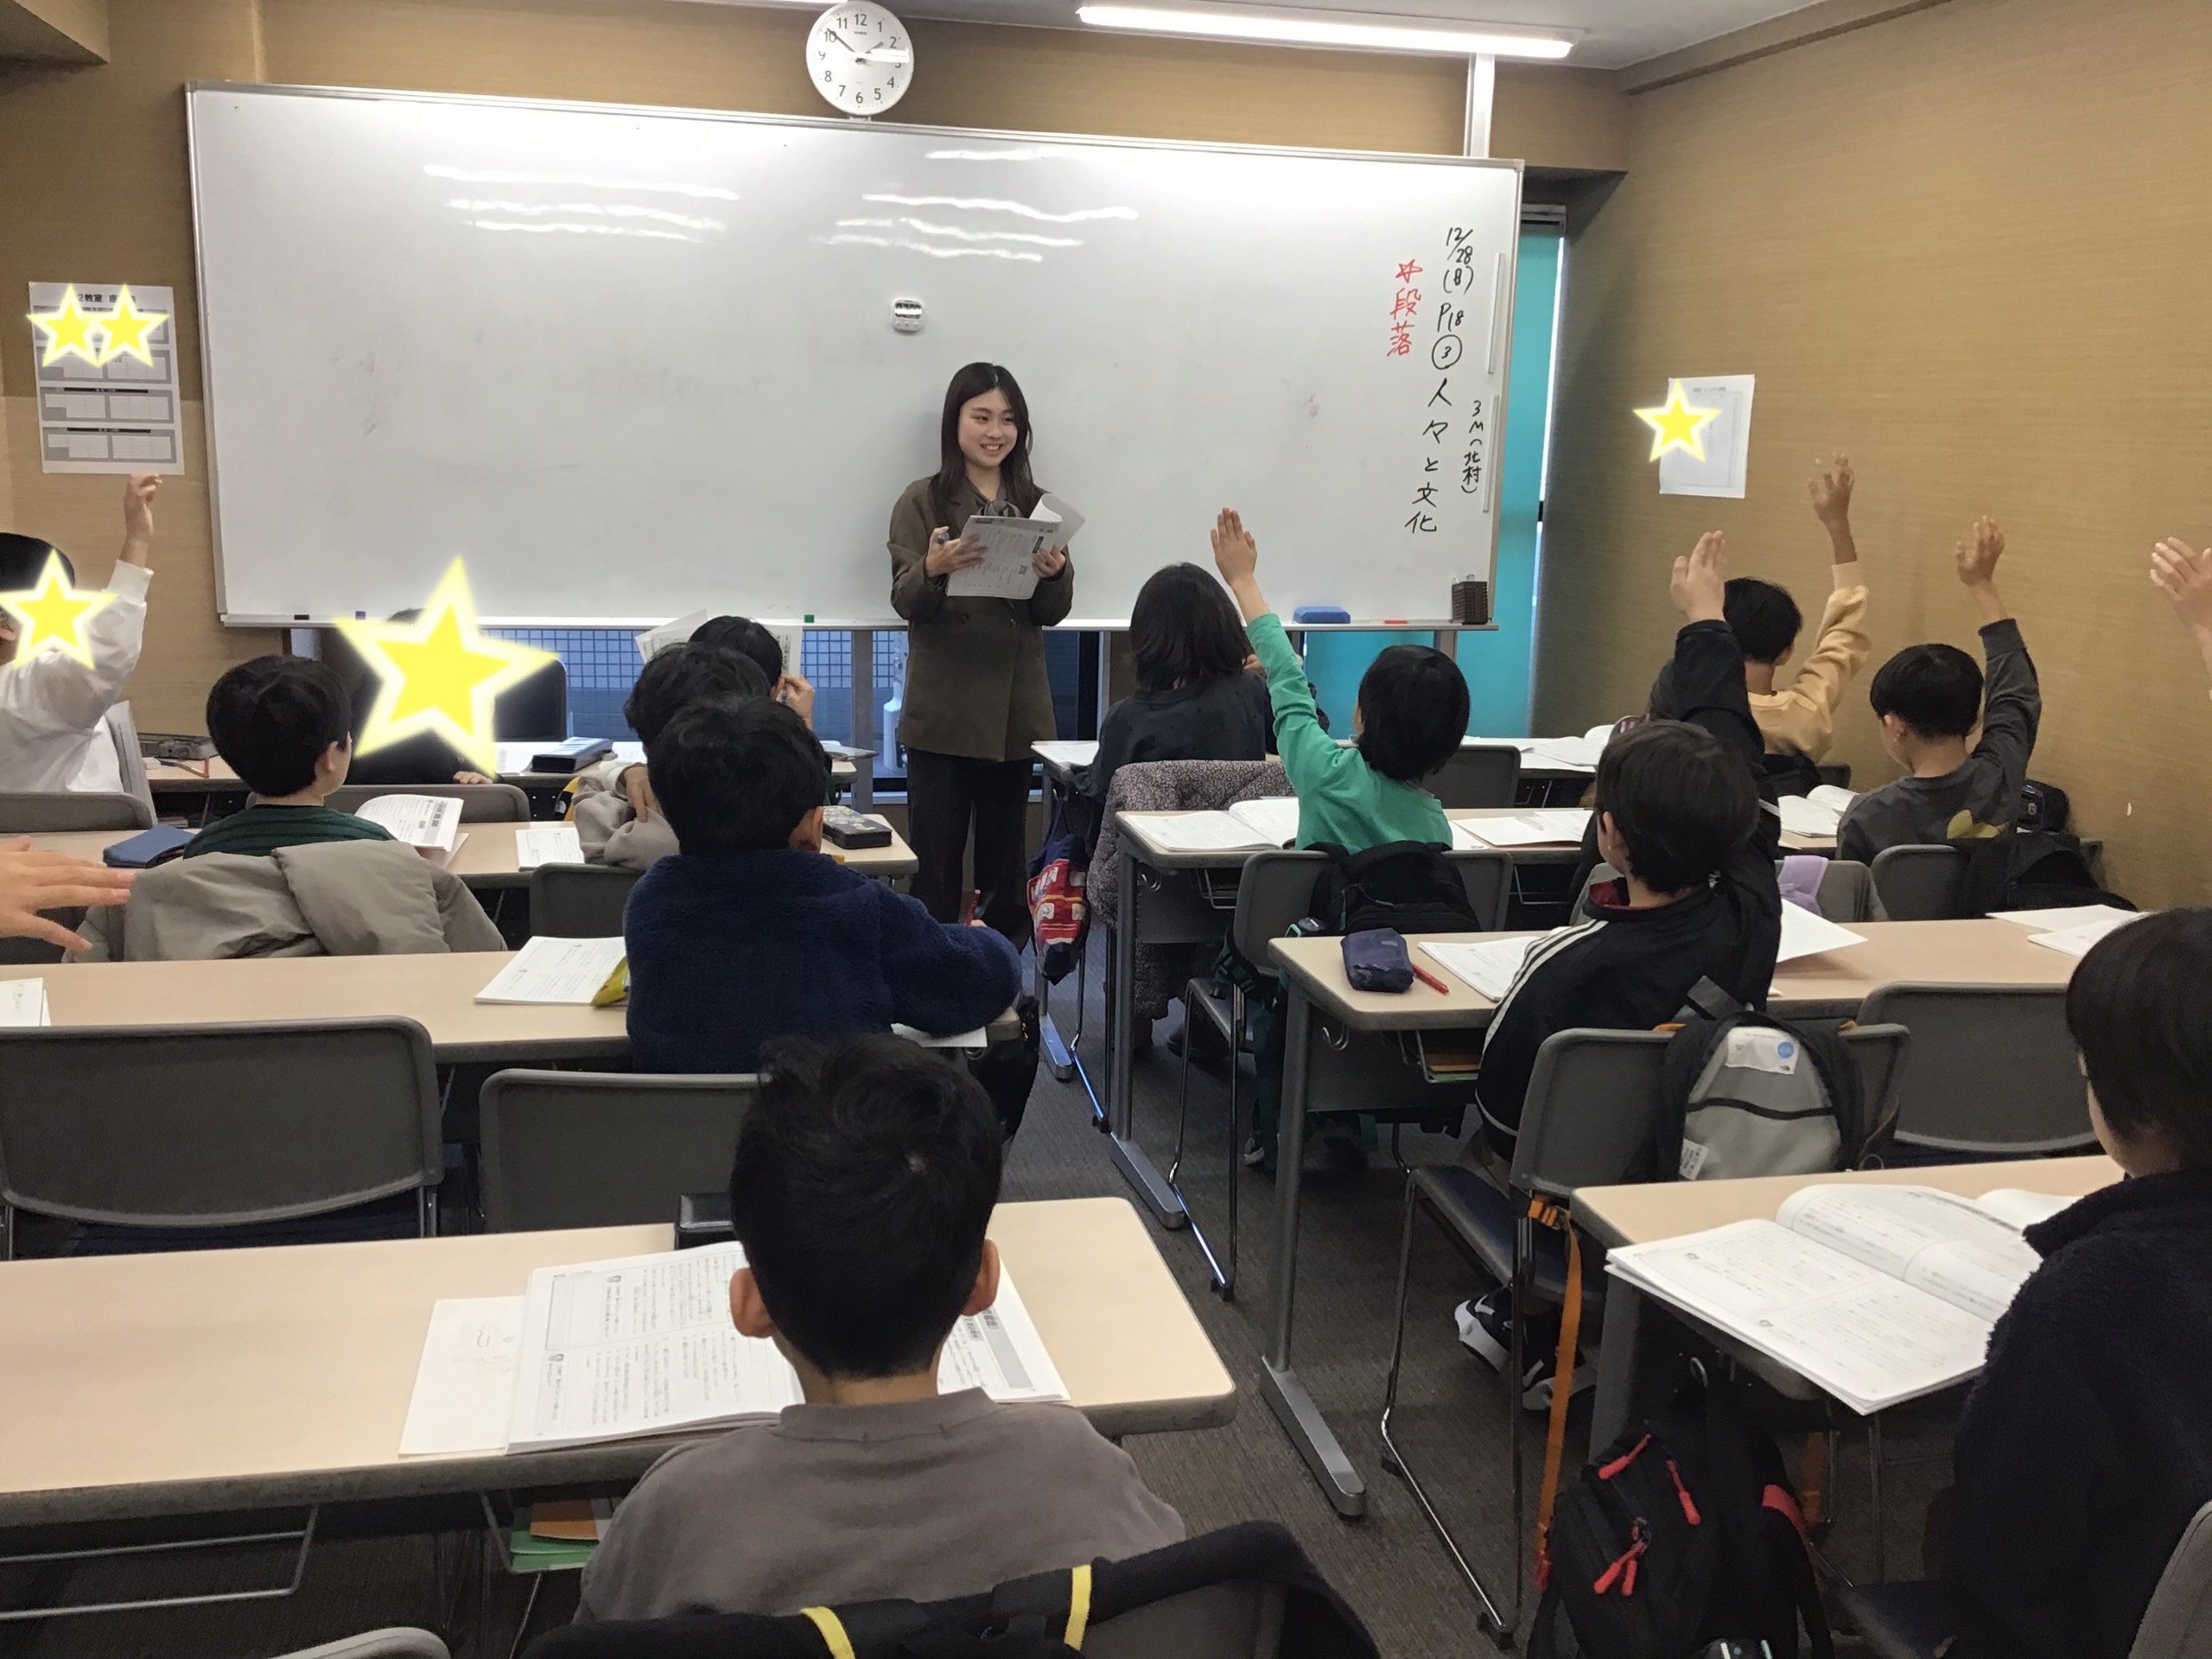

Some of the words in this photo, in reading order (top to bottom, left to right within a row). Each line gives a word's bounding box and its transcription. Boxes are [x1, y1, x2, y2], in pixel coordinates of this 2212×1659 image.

[836, 17, 848, 29] 11
[854, 14, 868, 26] 12
[877, 22, 882, 33] 1
[823, 30, 837, 43] 10
[889, 36, 897, 48] 2
[824, 70, 832, 82] 8
[887, 77, 894, 88] 4
[838, 85, 846, 97] 7
[874, 88, 881, 100] 5
[855, 92, 863, 104] 6
[1387, 288, 1421, 357] 段落
